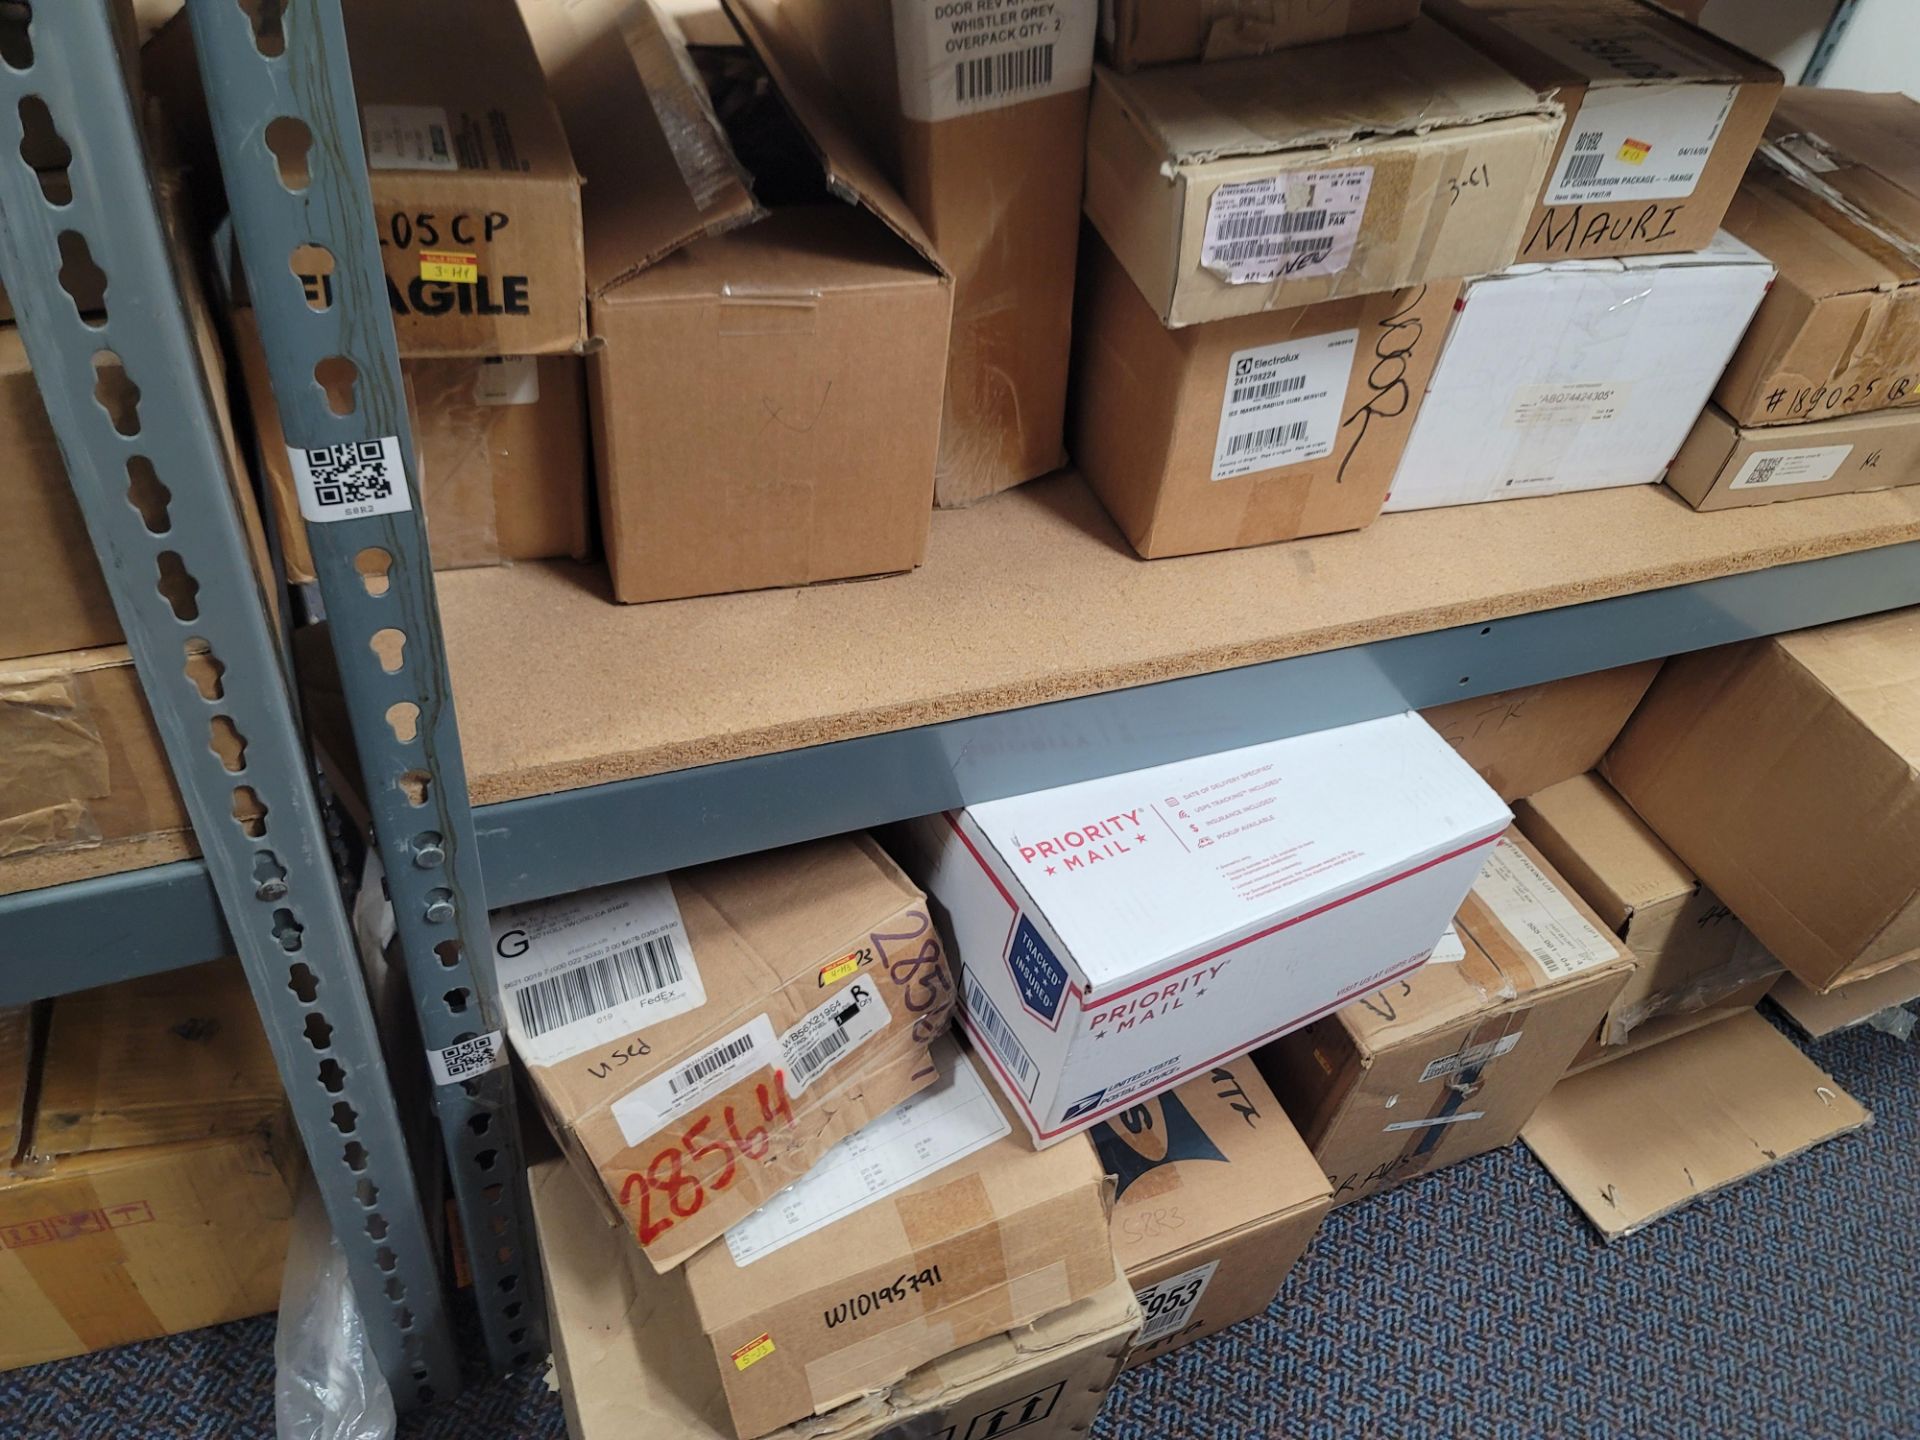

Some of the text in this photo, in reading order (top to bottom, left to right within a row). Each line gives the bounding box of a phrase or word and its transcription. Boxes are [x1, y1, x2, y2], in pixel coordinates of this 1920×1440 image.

[935, 1, 973, 20] DOOR
[951, 3, 1055, 34] WHISTLER GREY
[945, 28, 1015, 53] OVERPACK
[1054, 17, 1061, 32] 2
[1571, 176, 1619, 188] CONVERSION
[1620, 175, 1655, 185] PACKAGE
[1524, 204, 1685, 255] MAURI
[1276, 247, 1334, 277] New
[1254, 352, 1300, 369] Electrolux
[1183, 790, 1200, 800] DATE
[1200, 786, 1209, 794] OF
[1210, 775, 1240, 790] DELIVERY
[1194, 803, 1212, 813] USPS
[1206, 809, 1243, 826] INSURANCE
[1217, 814, 1276, 840] PICKUP AVAILABLE
[1063, 840, 1131, 872] MAIL
[496, 929, 530, 959] G
[640, 991, 676, 1008] FedEx
[850, 985, 869, 1003] R
[782, 1000, 842, 1049] WB56X21964
[1116, 997, 1184, 1034] MAIL
[587, 1038, 652, 1080] used
[1107, 1054, 1182, 1093] UNITED STATES
[1099, 1086, 1136, 1107] POSTAL
[618, 1068, 796, 1247] 28564
[824, 1265, 942, 1329] W10195791
[1140, 1279, 1203, 1321] 953
